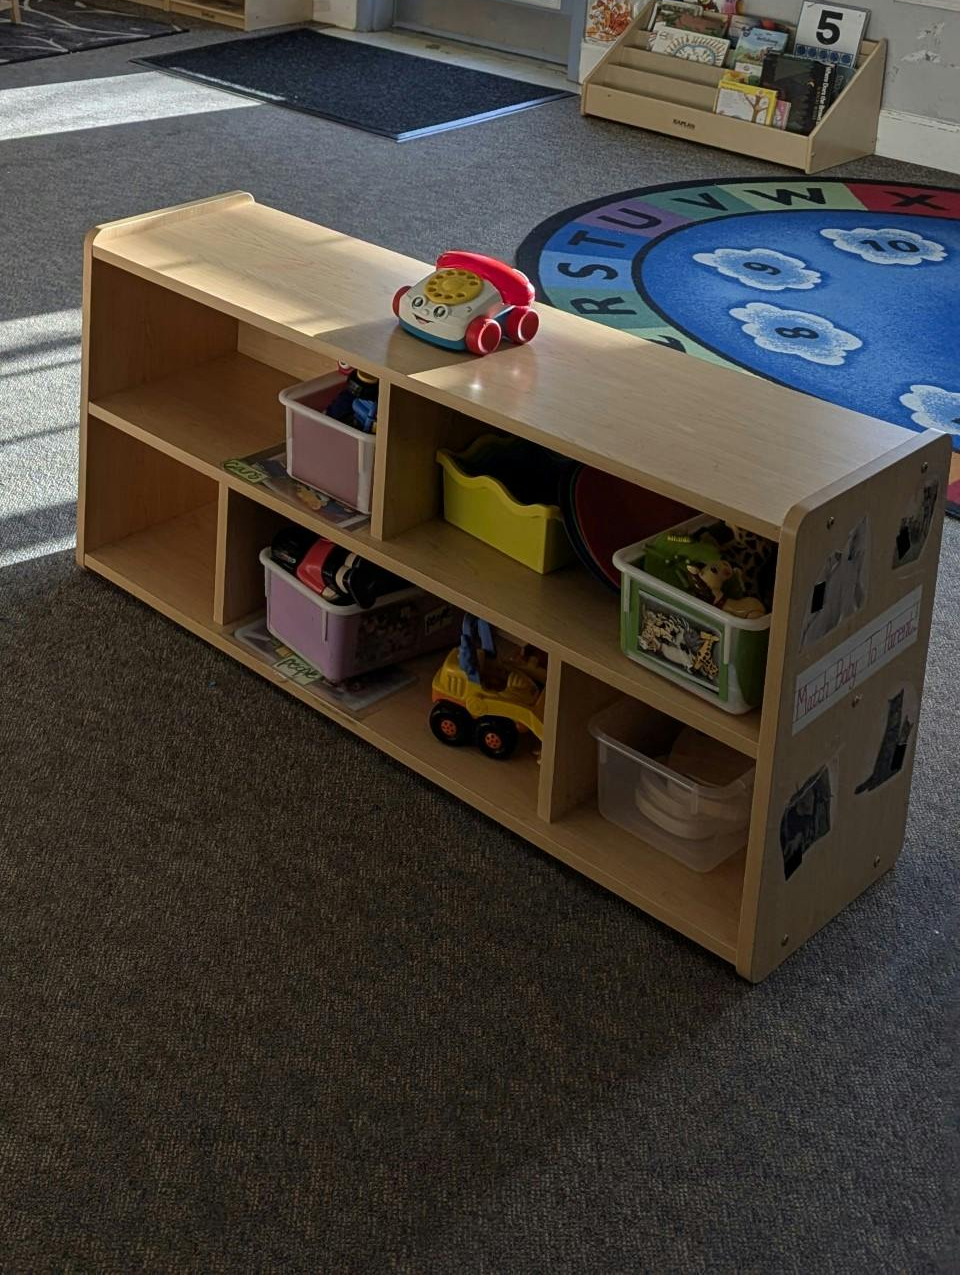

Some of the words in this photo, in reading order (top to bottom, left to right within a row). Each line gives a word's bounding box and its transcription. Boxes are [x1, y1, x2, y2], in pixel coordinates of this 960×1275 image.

[815, 9, 844, 46] 5
[671, 191, 730, 213] V
[743, 186, 828, 207] W
[884, 189, 949, 213] X
[596, 206, 663, 230] U
[568, 229, 626, 249] T
[860, 238, 921, 254] 10
[557, 261, 620, 281] S
[743, 261, 782, 277] 9
[570, 295, 637, 316] R
[774, 325, 821, 341] 8
[276, 658, 321, 680] people
[796, 669, 830, 720] Match
[834, 657, 858, 691] Baby
[867, 635, 878, 667] To
